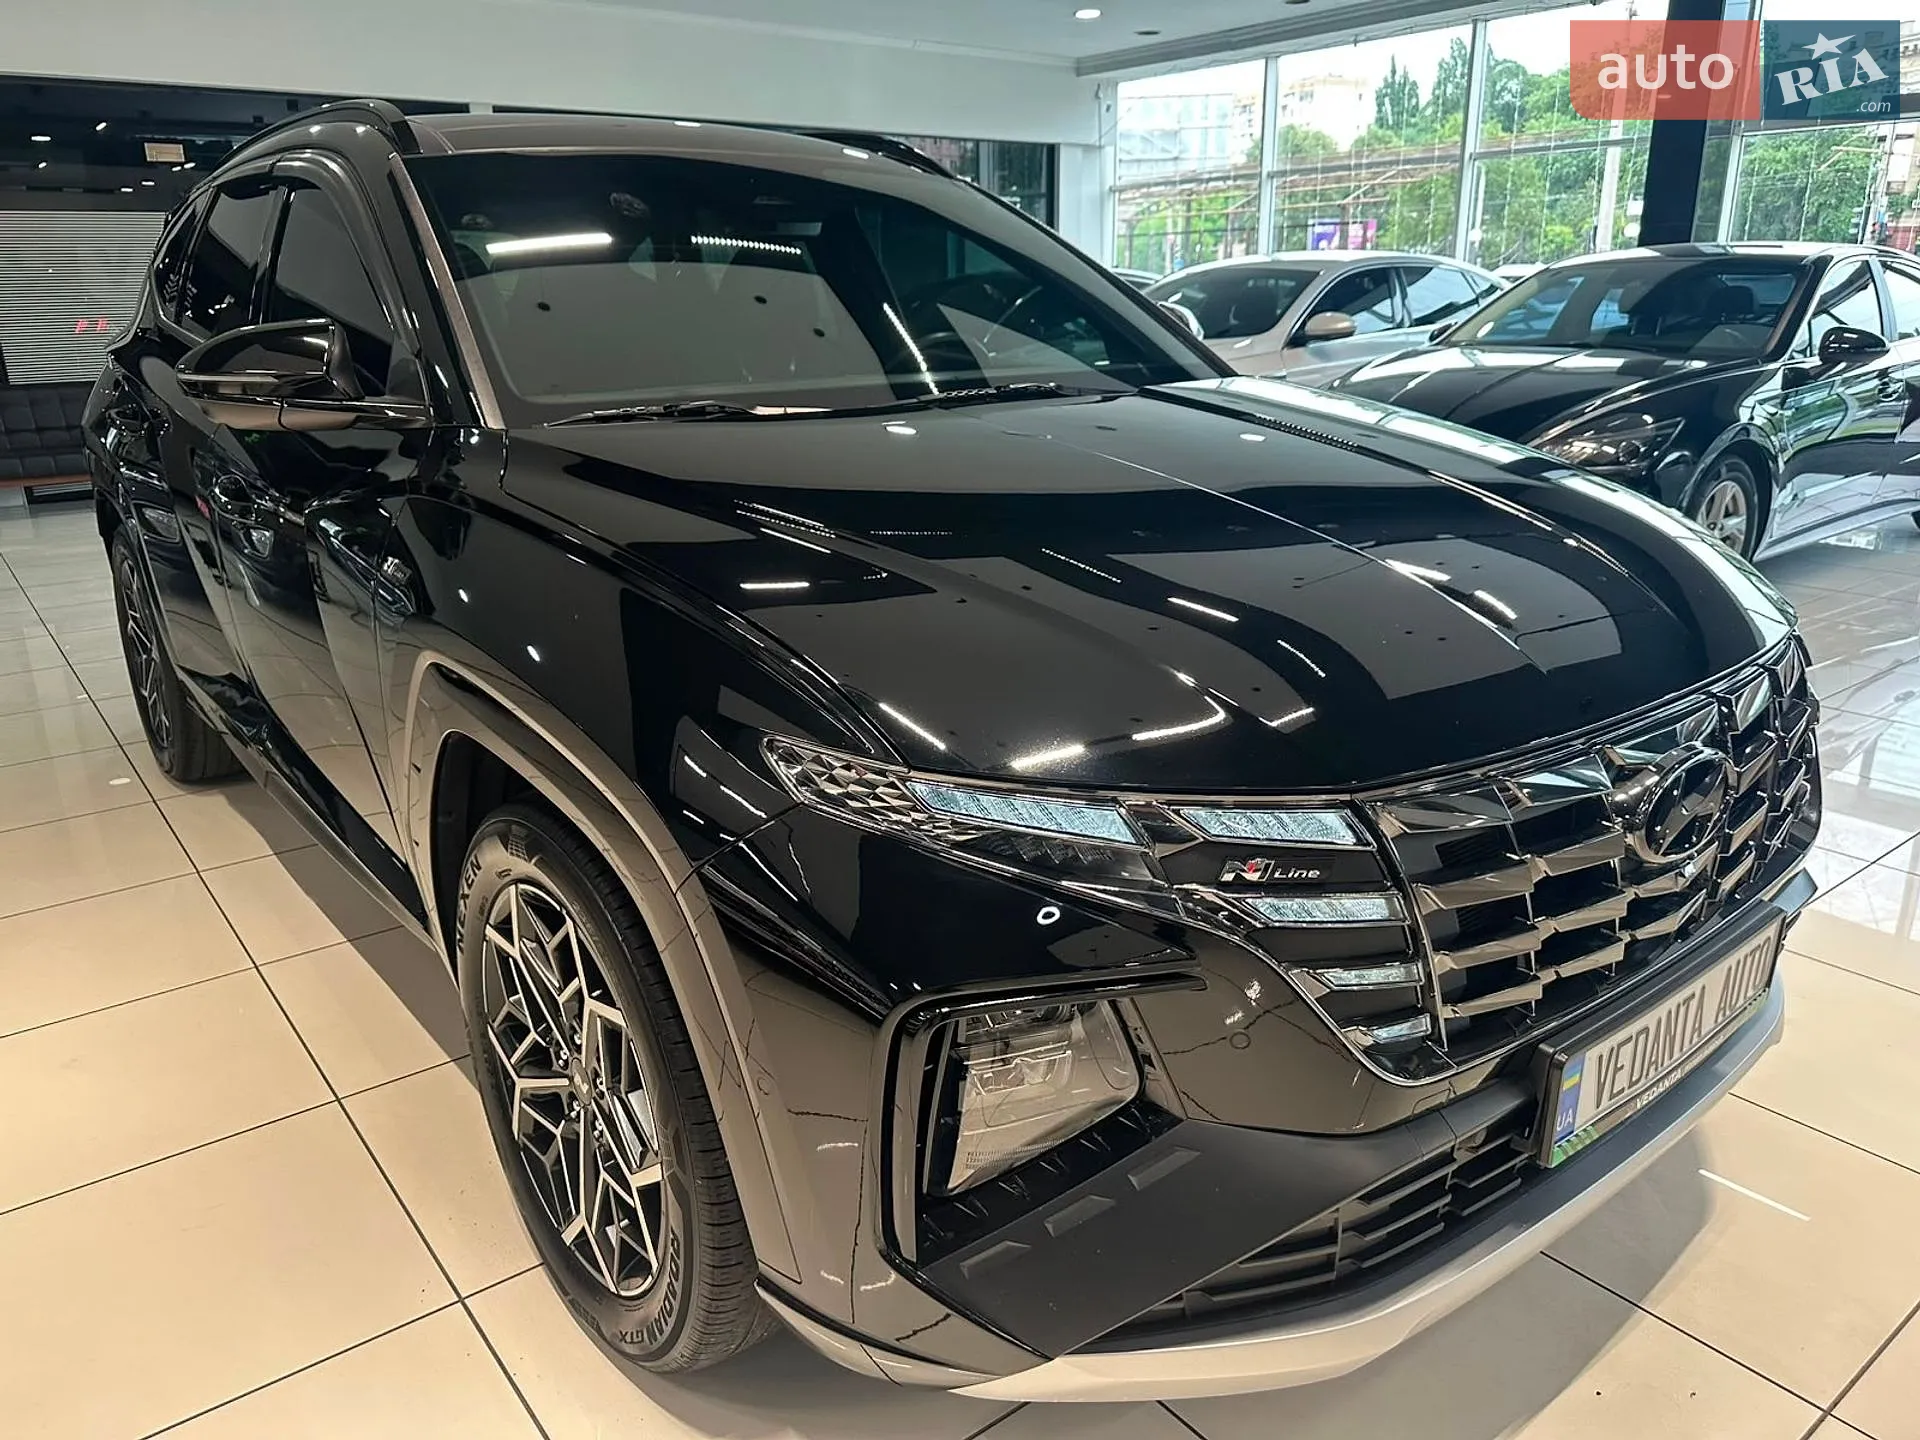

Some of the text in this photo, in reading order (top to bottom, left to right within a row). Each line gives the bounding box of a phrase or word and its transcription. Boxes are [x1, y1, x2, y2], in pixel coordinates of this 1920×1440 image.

[457, 853, 482, 956] NEXEN
[1274, 868, 1321, 879] Line
[1596, 984, 1706, 1109] VEDANTA
[1715, 936, 1771, 1024] AUTO
[1556, 1110, 1575, 1132] UA
[619, 1226, 681, 1346] ROADIAN GTX
